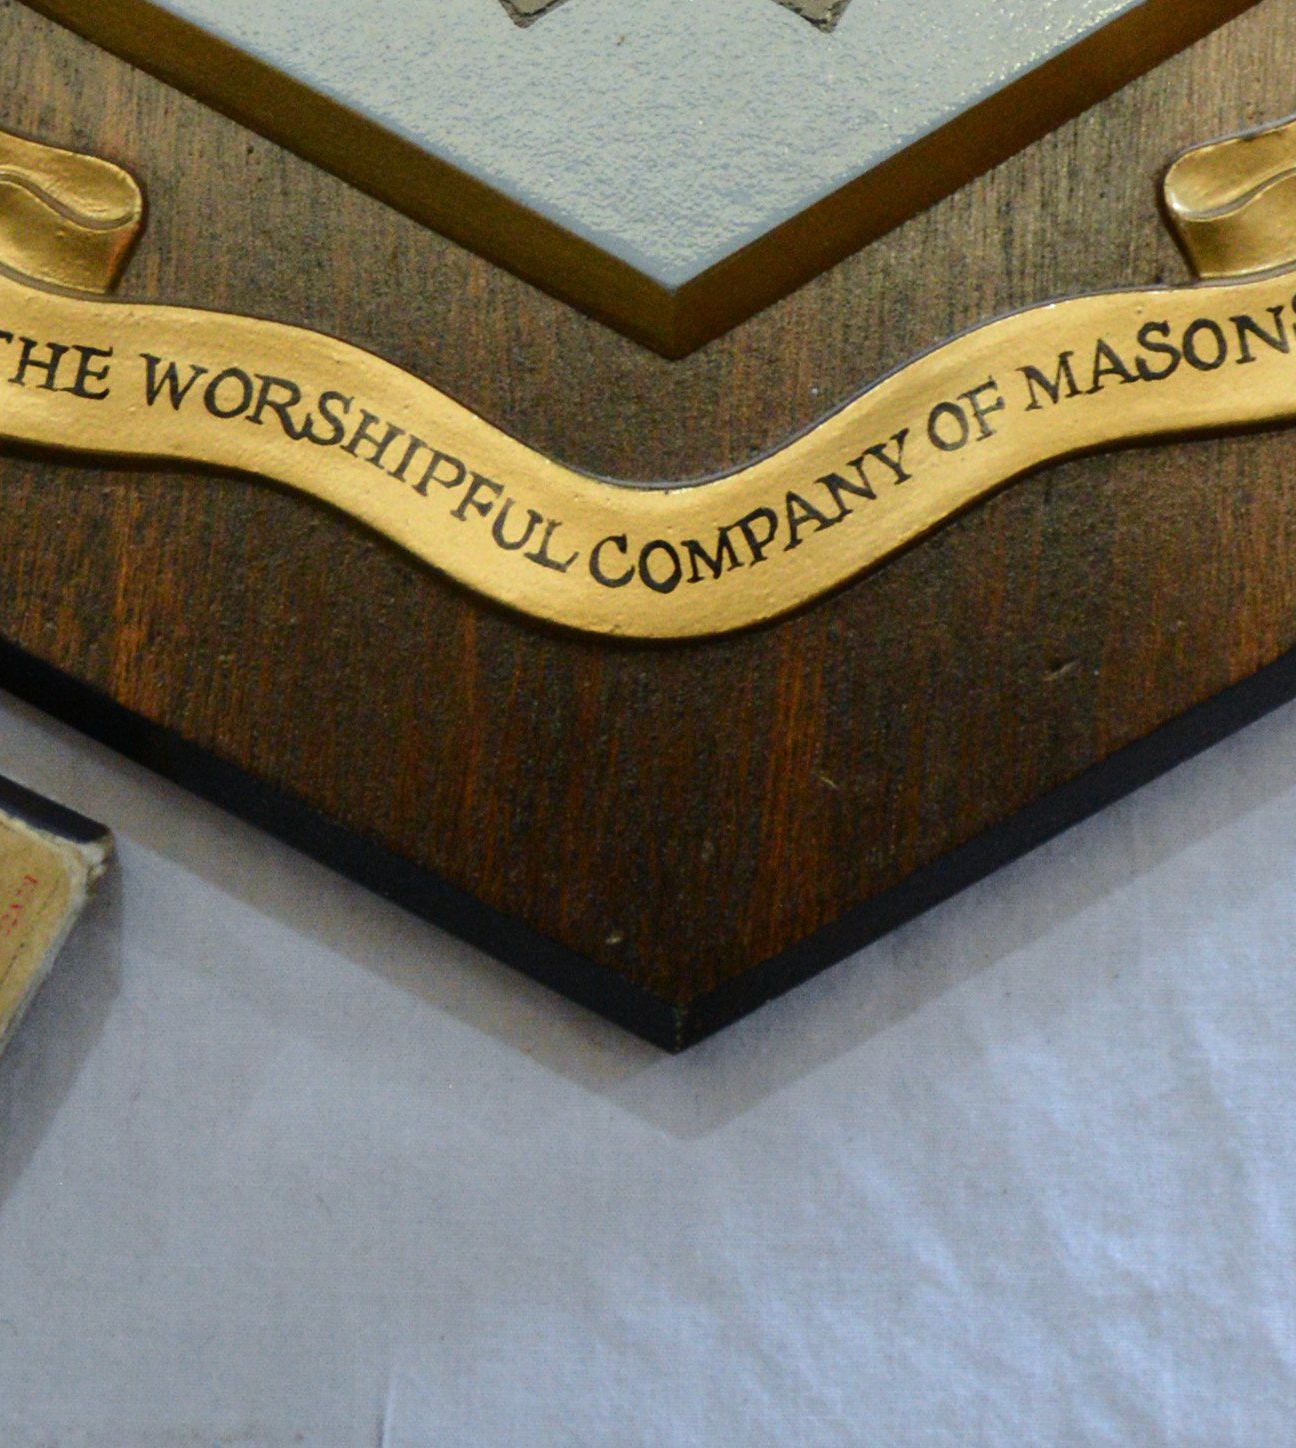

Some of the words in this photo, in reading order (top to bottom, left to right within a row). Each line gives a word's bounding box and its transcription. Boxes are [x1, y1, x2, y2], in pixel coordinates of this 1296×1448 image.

[140, 352, 583, 573] WORSHIPFUL
[589, 428, 912, 595] COMPANY
[926, 378, 1006, 452] OF
